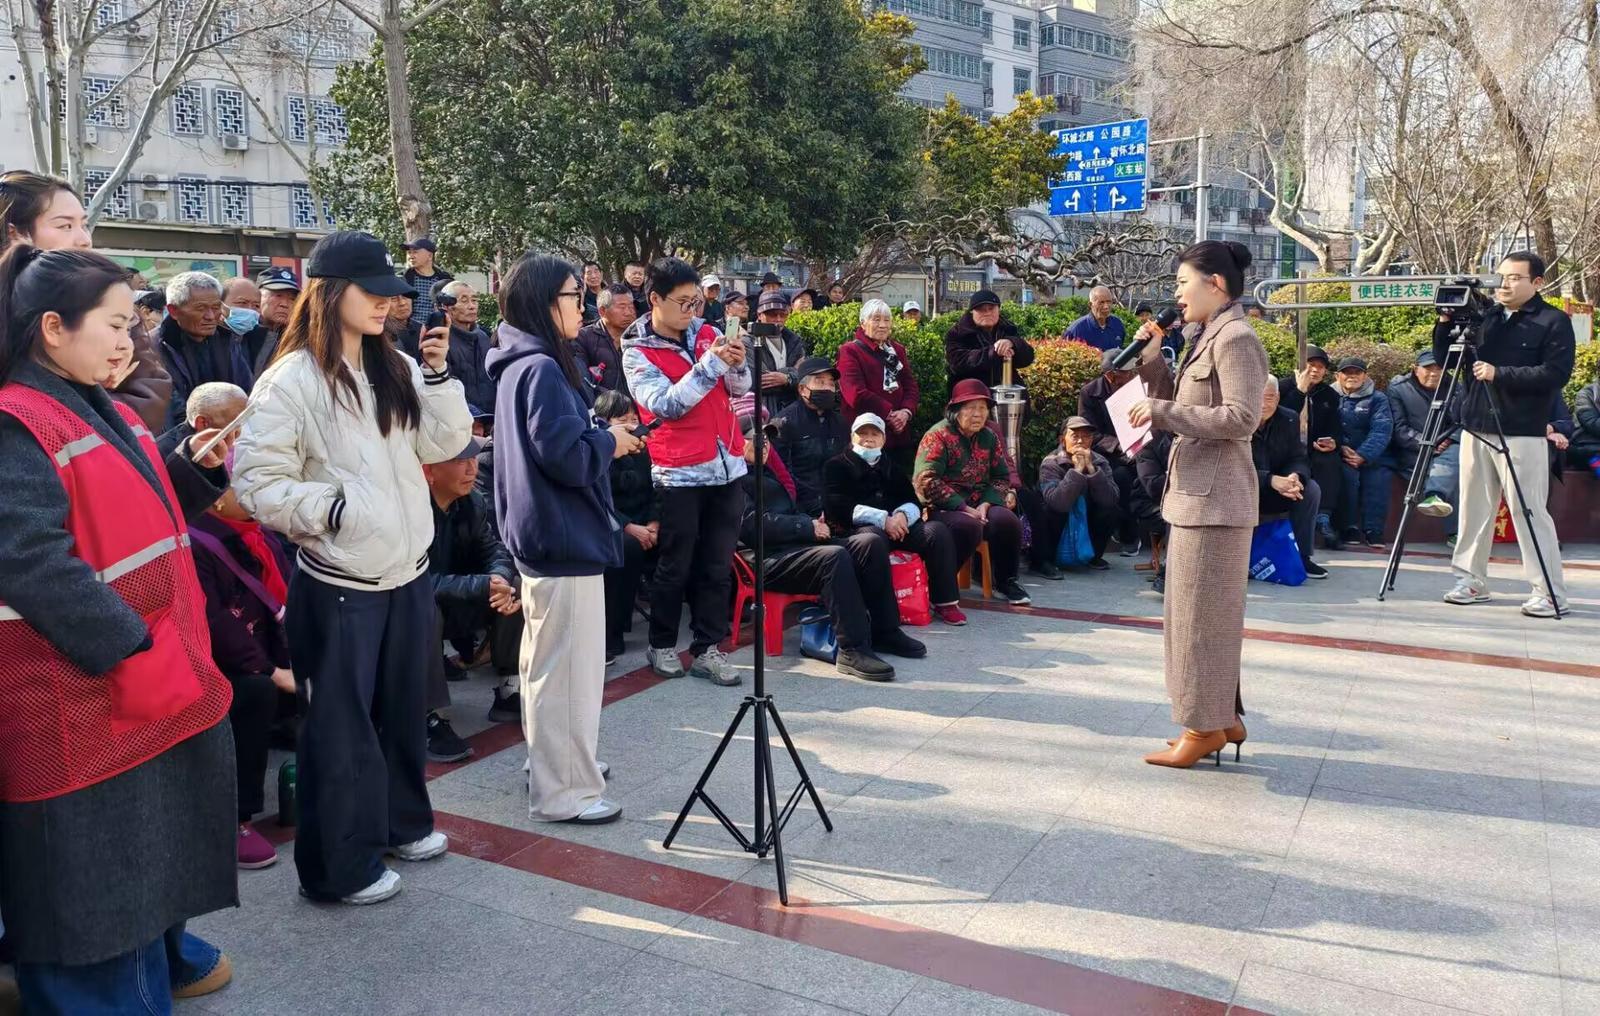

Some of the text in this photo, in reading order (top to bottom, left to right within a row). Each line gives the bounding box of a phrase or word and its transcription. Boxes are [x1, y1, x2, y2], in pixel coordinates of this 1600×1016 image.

[1100, 125, 1131, 140] 公园路
[1116, 163, 1144, 176] 火车站
[1358, 283, 1434, 299] 便民挂衣架
